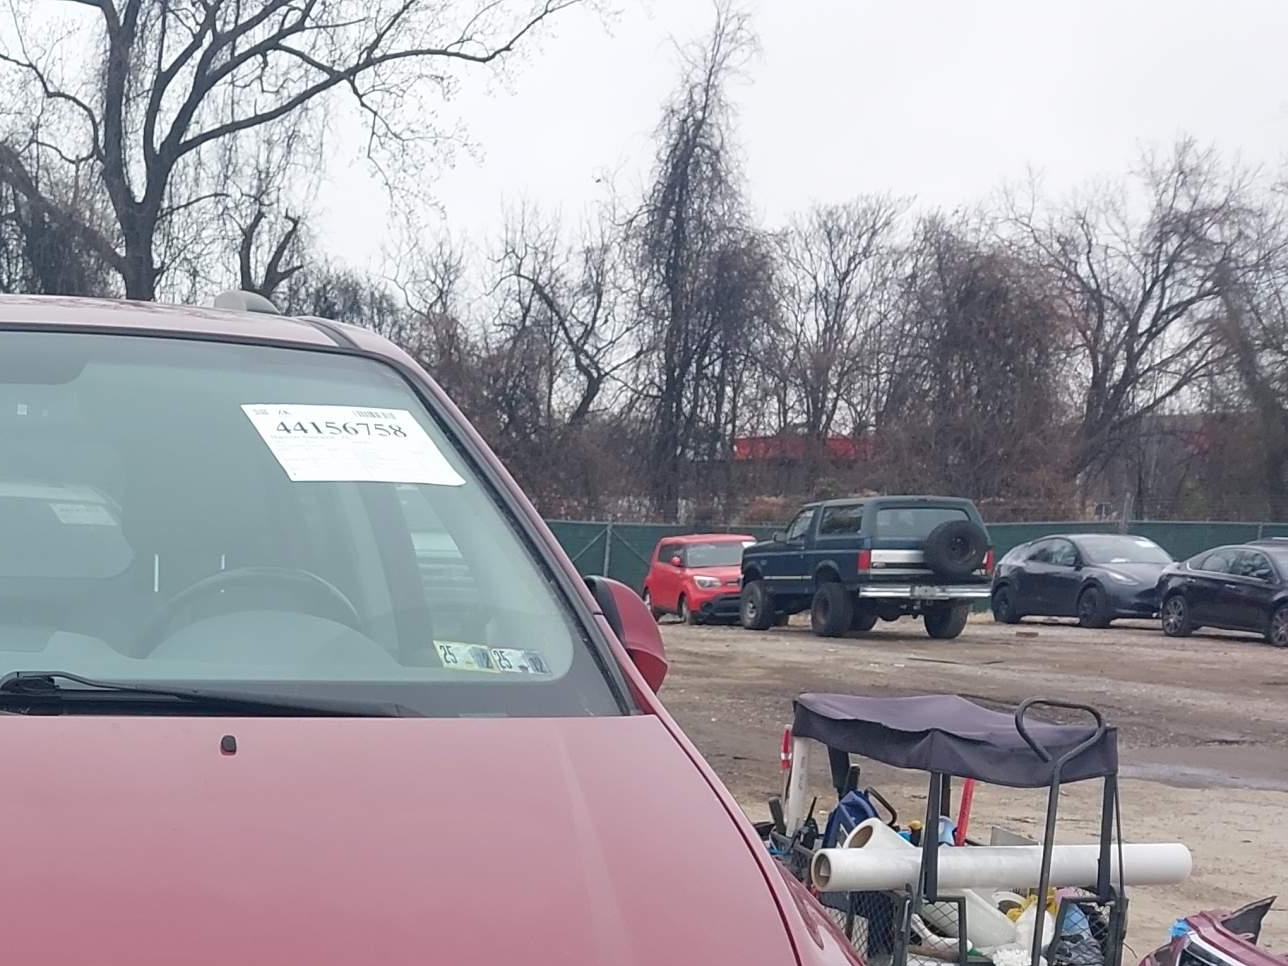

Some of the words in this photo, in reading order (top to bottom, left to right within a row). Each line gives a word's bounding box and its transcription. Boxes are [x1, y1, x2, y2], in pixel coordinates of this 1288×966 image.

[276, 420, 407, 438] 44156758
[439, 644, 458, 665] 25
[492, 649, 513, 670] 25
